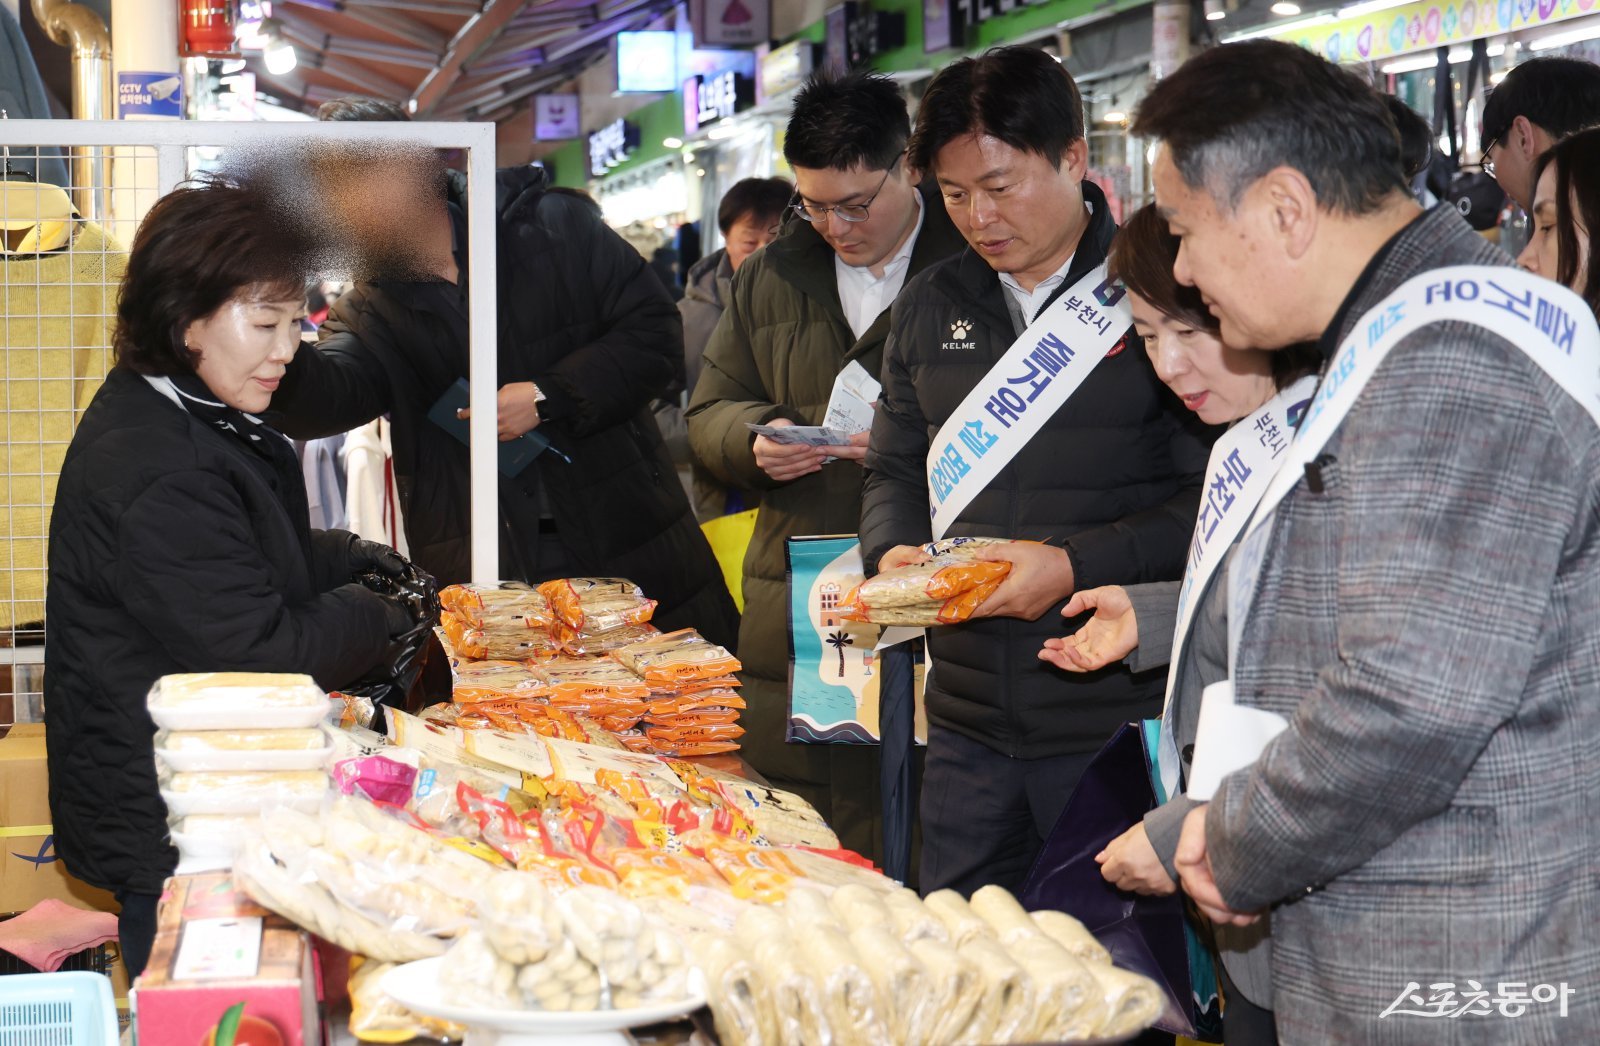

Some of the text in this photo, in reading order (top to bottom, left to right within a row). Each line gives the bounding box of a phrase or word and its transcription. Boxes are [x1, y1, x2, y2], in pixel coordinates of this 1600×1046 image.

[119, 83, 142, 93] CCTV
[119, 94, 152, 105] 설치안내
[1063, 295, 1113, 337] 부천시
[1367, 299, 1409, 350] 설
[1425, 279, 1578, 355] 즐거운
[942, 342, 976, 350] KELME
[983, 331, 1076, 429] 즐거운
[957, 418, 1000, 460] 설
[1253, 411, 1289, 461] 부천시
[929, 441, 973, 505] 명절
